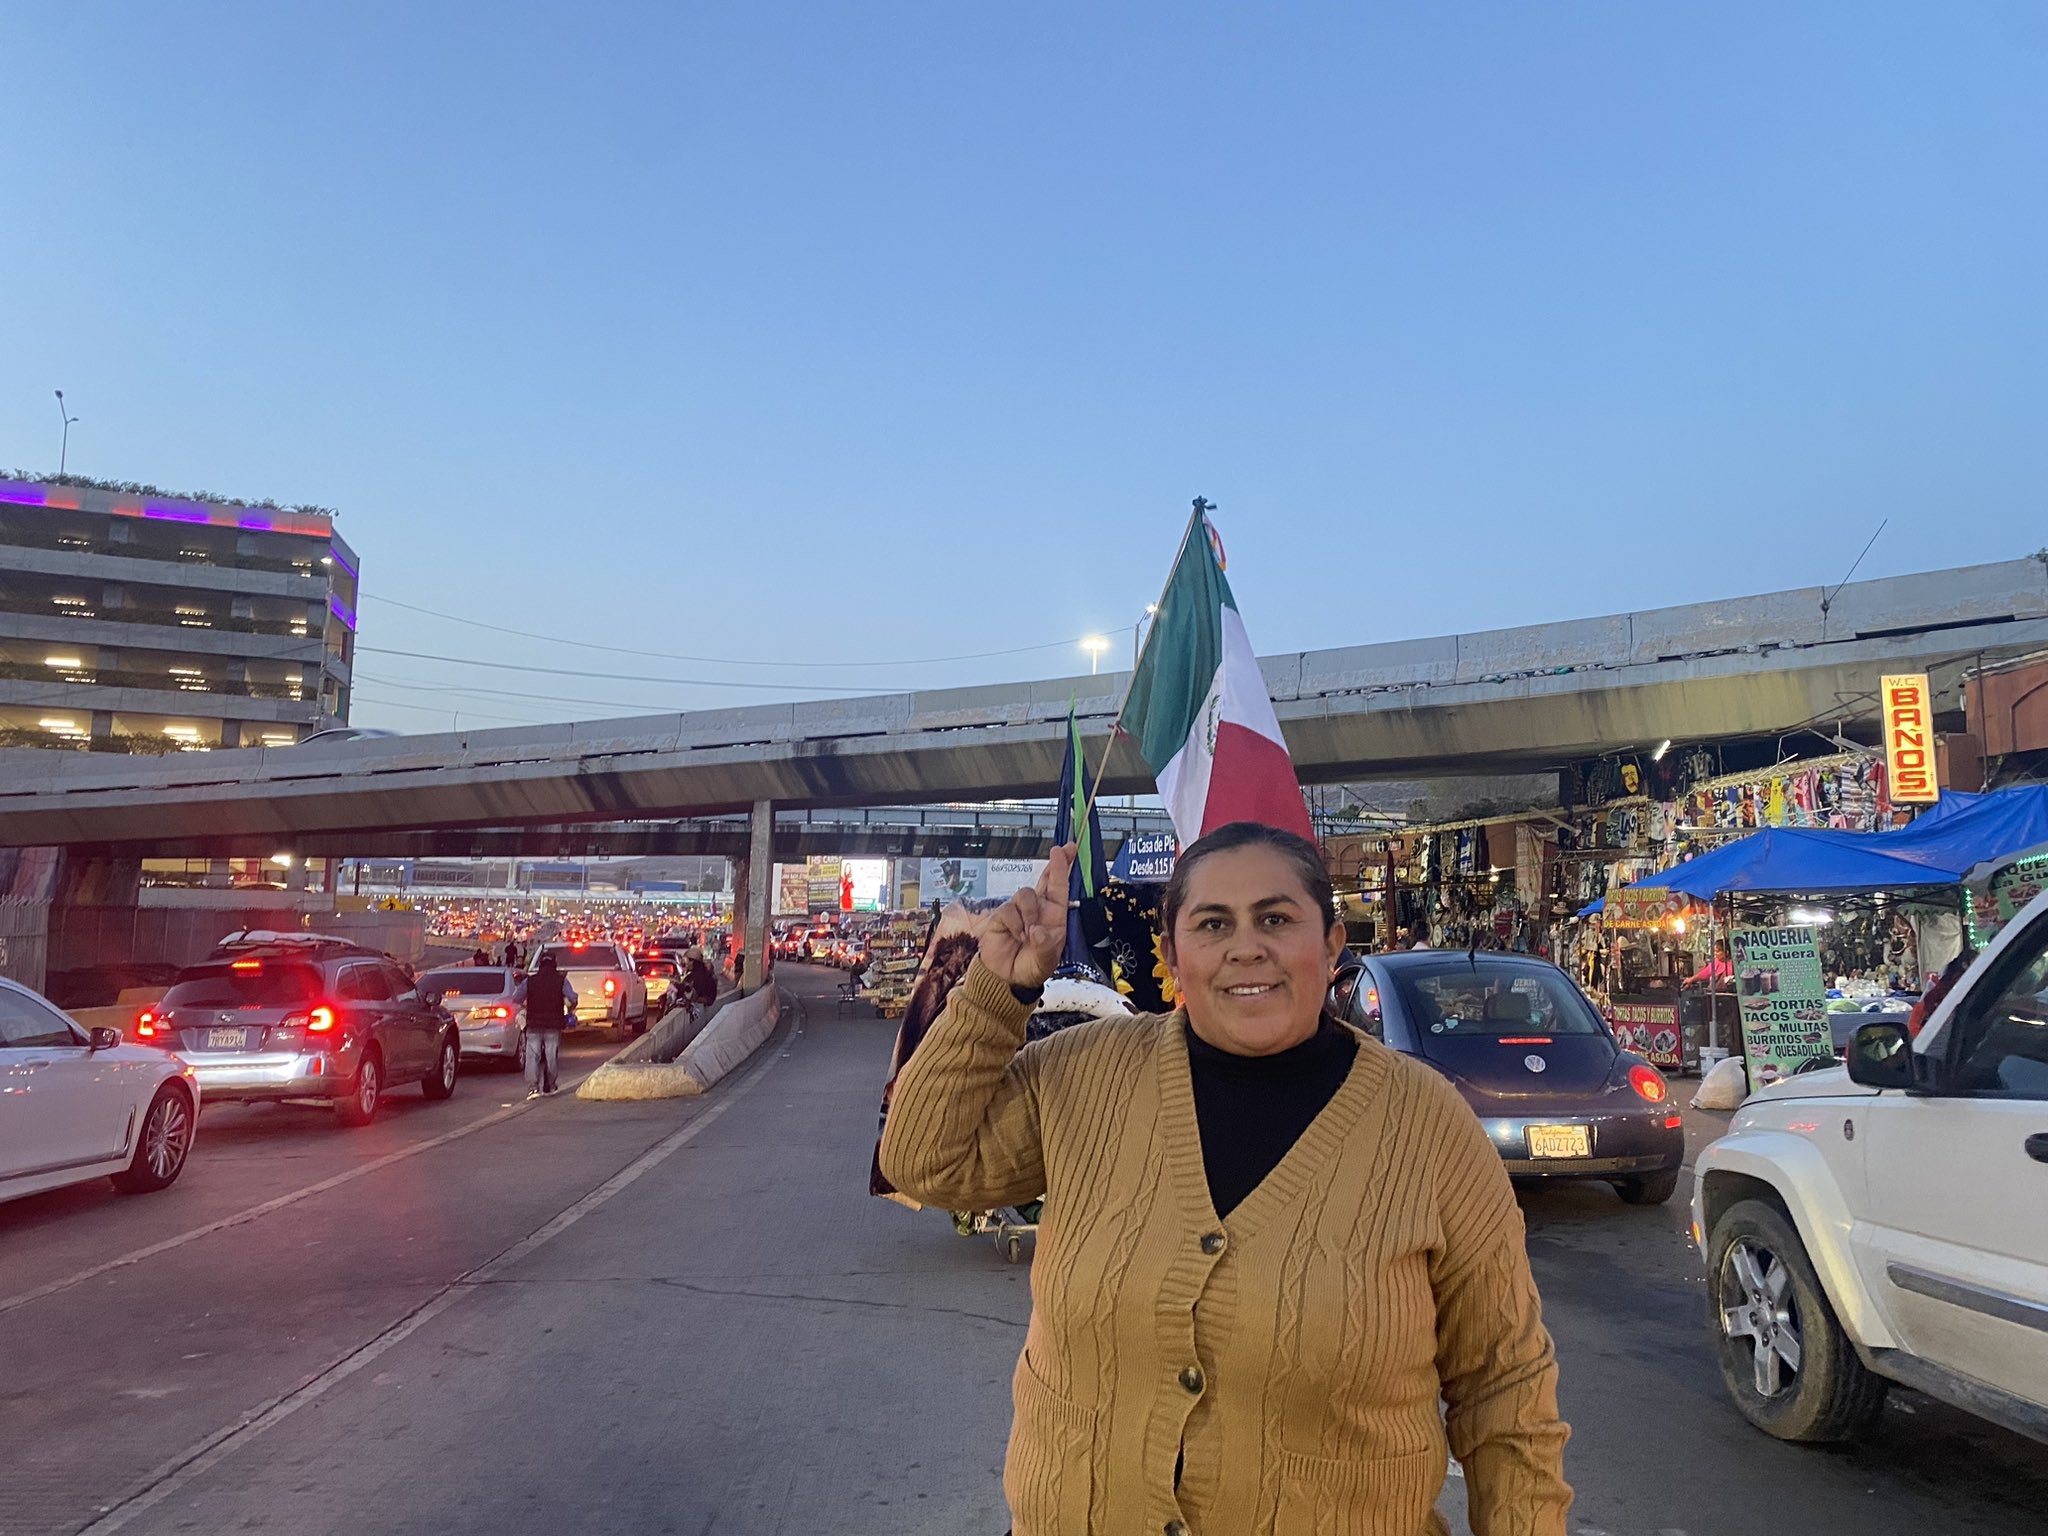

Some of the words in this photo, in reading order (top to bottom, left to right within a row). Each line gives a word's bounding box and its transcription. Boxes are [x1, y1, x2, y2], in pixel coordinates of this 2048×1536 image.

[1888, 678, 1919, 687] W.C.
[1891, 687, 1927, 791] BAÑOS
[1128, 838, 1136, 854] Tu
[1137, 838, 1153, 853] Casa
[1154, 835, 1163, 852] de
[1129, 858, 1154, 875] Desde
[1155, 857, 1168, 875] 115
[1604, 920, 1614, 928] DE
[1615, 920, 1640, 928] CARNE
[1743, 928, 1812, 948] TAQUERIA
[1752, 951, 1768, 961] La
[1771, 999, 1823, 1010] TORTAS
[1744, 1012, 1790, 1022] TACOS
[1779, 1022, 1829, 1033] MULITAS
[1747, 1034, 1802, 1045] BURRITOS
[1775, 1044, 1830, 1058] QUESADILLAS
[1651, 1052, 1679, 1064] ASADA
[1535, 1137, 1585, 1151] 6ADZ723
